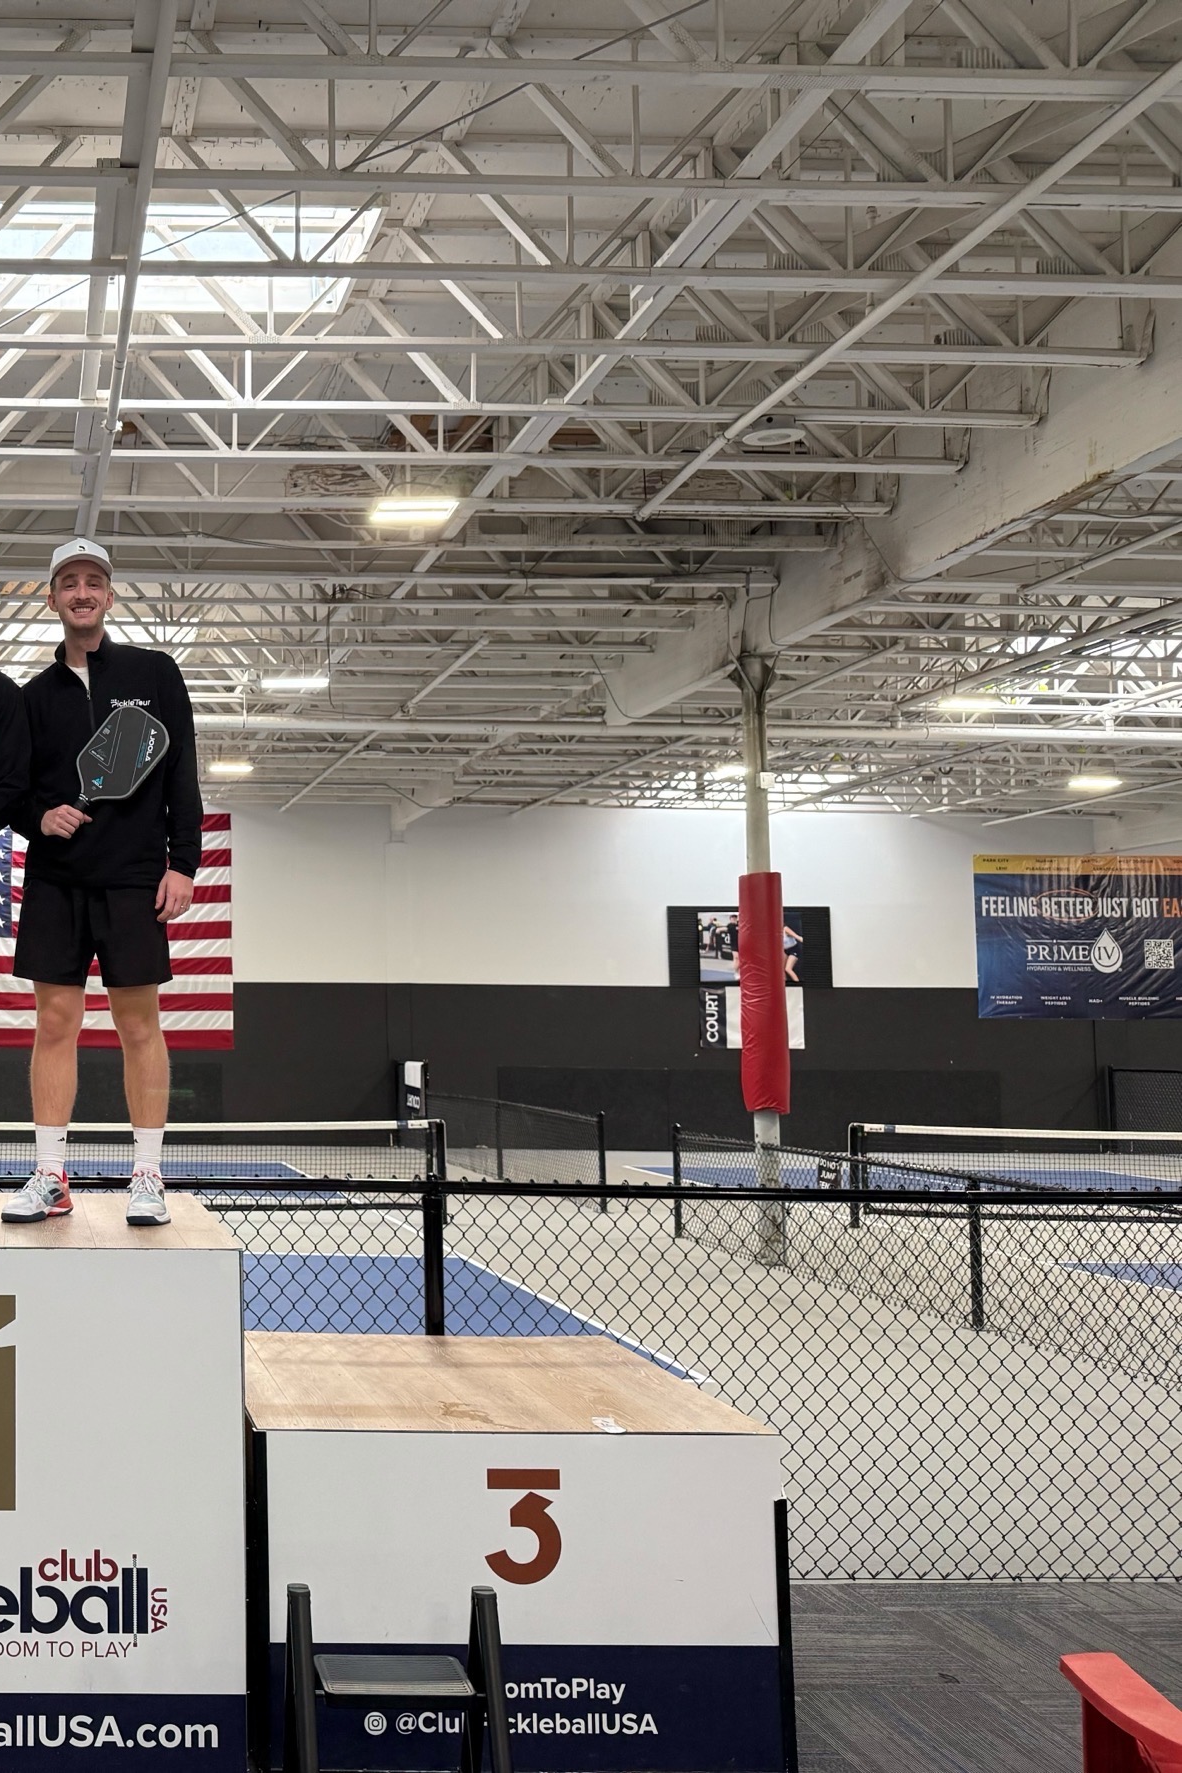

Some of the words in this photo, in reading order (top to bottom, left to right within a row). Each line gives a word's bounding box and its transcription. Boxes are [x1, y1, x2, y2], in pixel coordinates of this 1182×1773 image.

[144, 735, 157, 762] JOOLA
[981, 895, 1038, 917] FEELING
[1041, 896, 1093, 918] BETTER
[1097, 897, 1129, 918] JUST
[1132, 898, 1159, 918] GOT
[1026, 939, 1091, 962] PRIME
[1097, 946, 1116, 961] IV
[705, 992, 719, 1043] COURT
[484, 1468, 562, 1586] 3
[38, 1548, 119, 1582] club
[150, 1586, 169, 1634] USA
[46, 1641, 74, 1658] TO
[81, 1641, 132, 1658] PLAY
[505, 1677, 627, 1704] omToPlay
[395, 1710, 659, 1736] @CluckleballUSA
